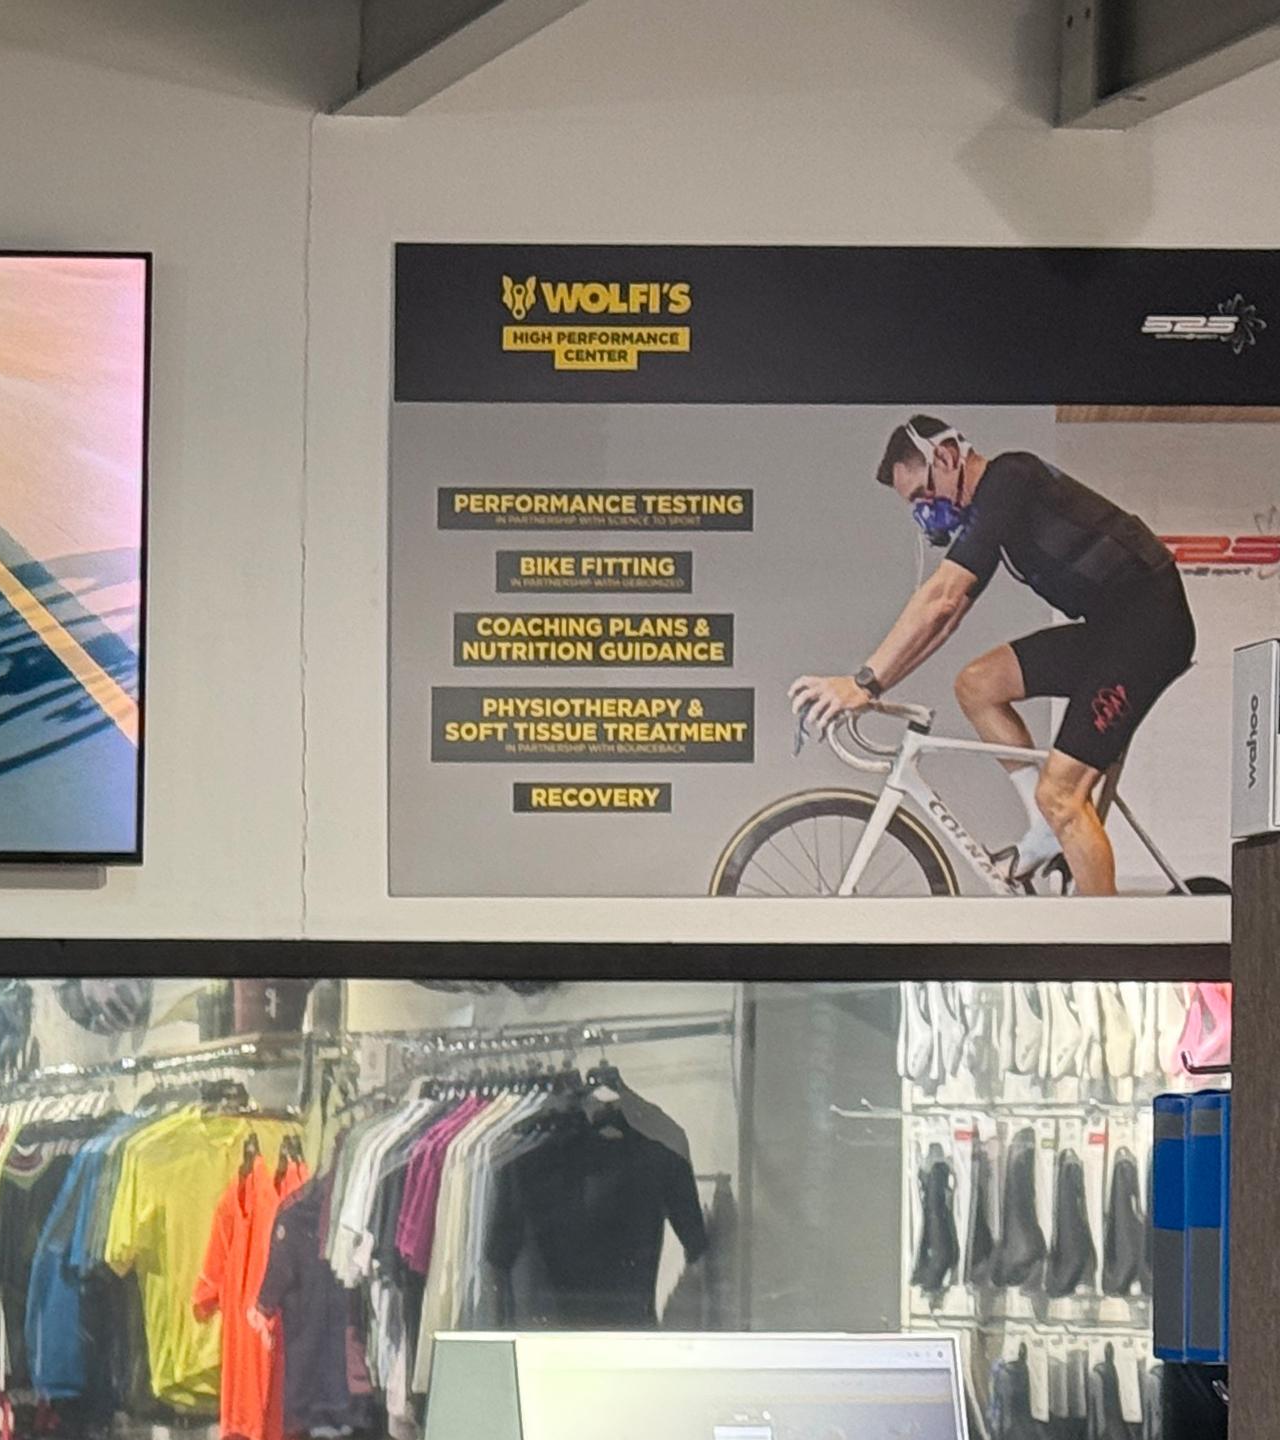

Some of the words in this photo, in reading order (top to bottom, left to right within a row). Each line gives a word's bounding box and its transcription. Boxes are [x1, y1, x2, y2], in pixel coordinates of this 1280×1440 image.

[541, 282, 692, 314] WOLFI'S
[513, 331, 553, 345] HIGH
[557, 331, 680, 346] PERFORMANCE
[564, 349, 629, 363] CENTER
[453, 494, 637, 515] PERFORMANCE
[642, 495, 745, 515] TESTING
[519, 556, 577, 577] BIKE
[581, 557, 677, 577] FITTING
[477, 617, 603, 638] COACHING
[609, 617, 689, 638] PLANS
[693, 617, 711, 638] &
[462, 641, 595, 662] NUTRITION
[599, 641, 725, 663] GUIDANCE
[482, 698, 683, 718] PHYSIOTHERAPY
[687, 698, 704, 717] &
[445, 722, 508, 742] SOFT
[513, 722, 598, 742] TISSUE
[603, 722, 748, 743] TREATMENT
[531, 788, 661, 807] RECOVERY
